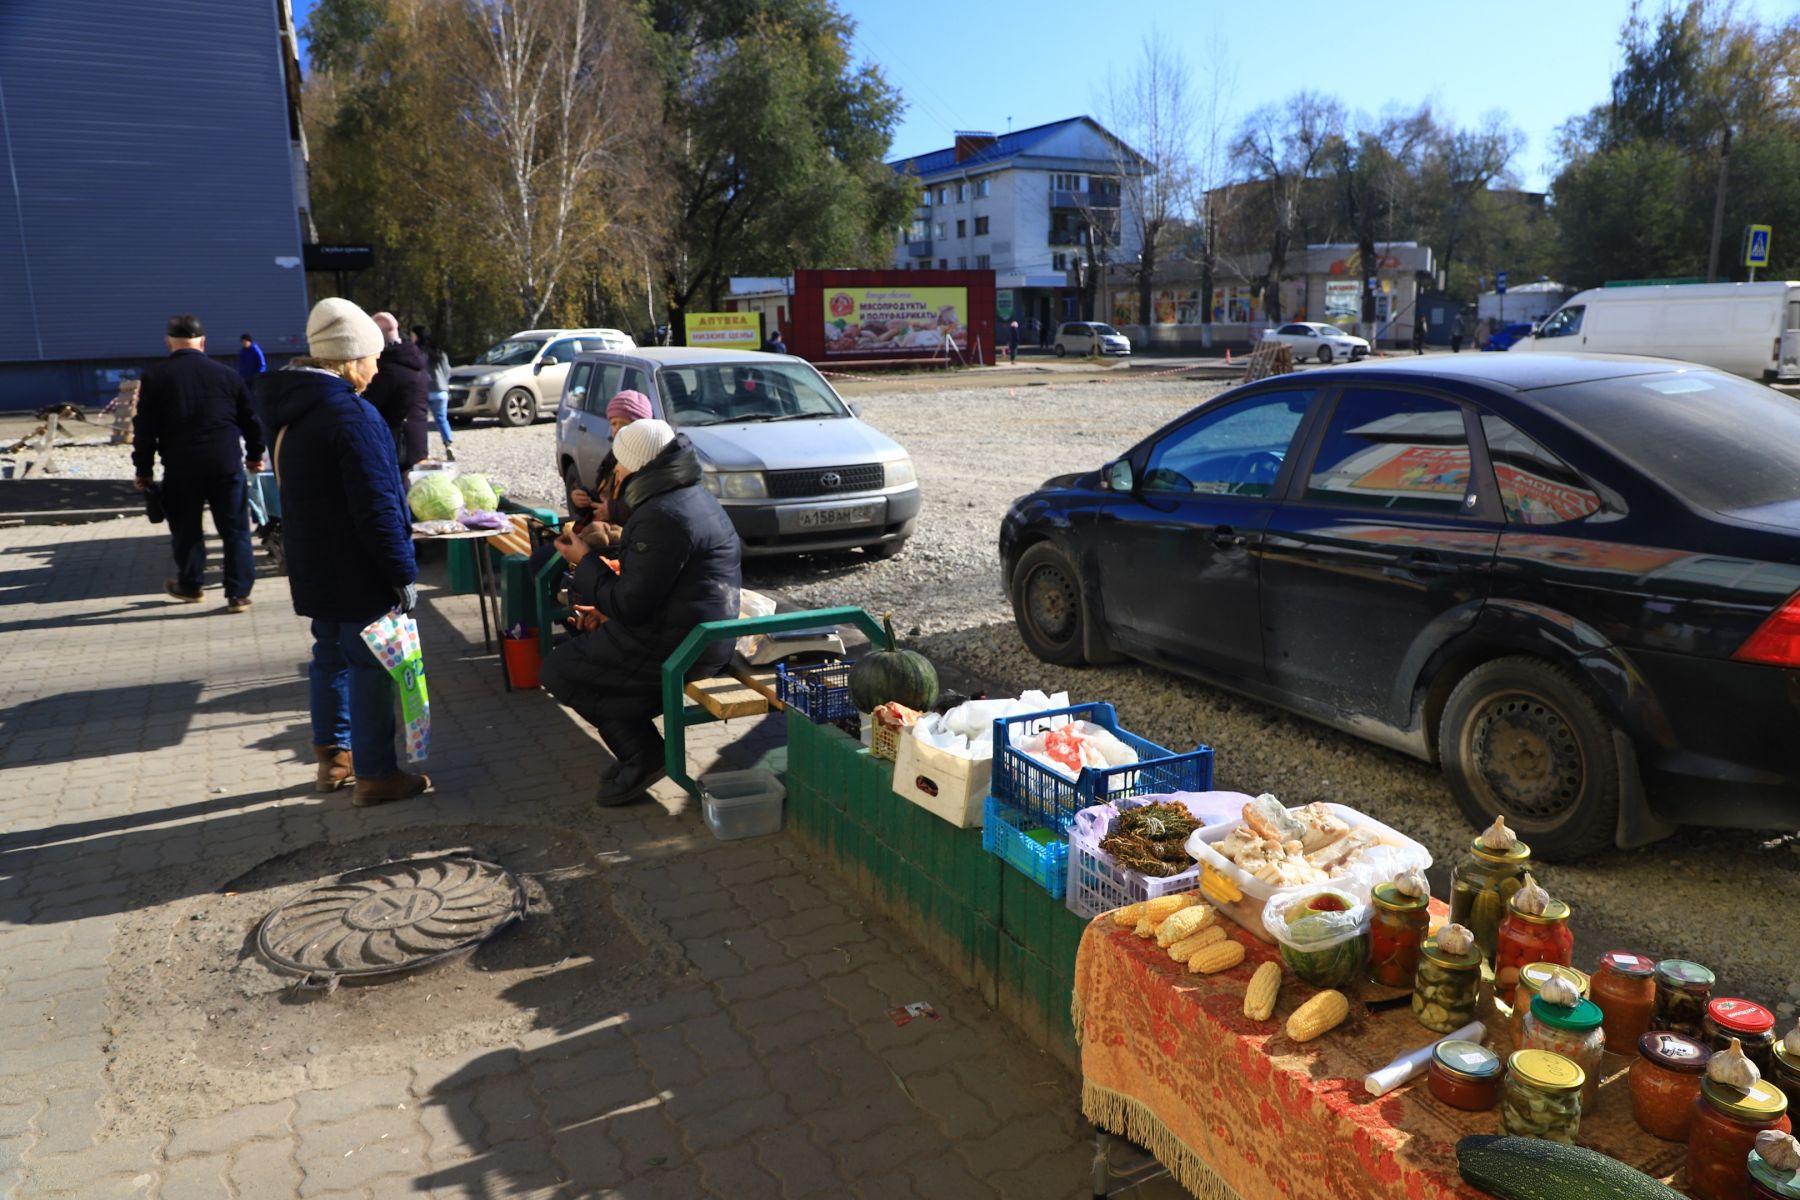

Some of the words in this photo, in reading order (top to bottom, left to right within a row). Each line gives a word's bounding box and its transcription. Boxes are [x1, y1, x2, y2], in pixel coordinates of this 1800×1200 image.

[860, 302, 927, 311] МЯСОПРОДУКТЫ
[867, 311, 938, 320] ПОЛУФАБРИКАТЫ
[699, 316, 748, 325] АПТЕКА
[692, 332, 726, 341] НИЗКИЕ
[728, 331, 754, 341] ЦЕНЫ
